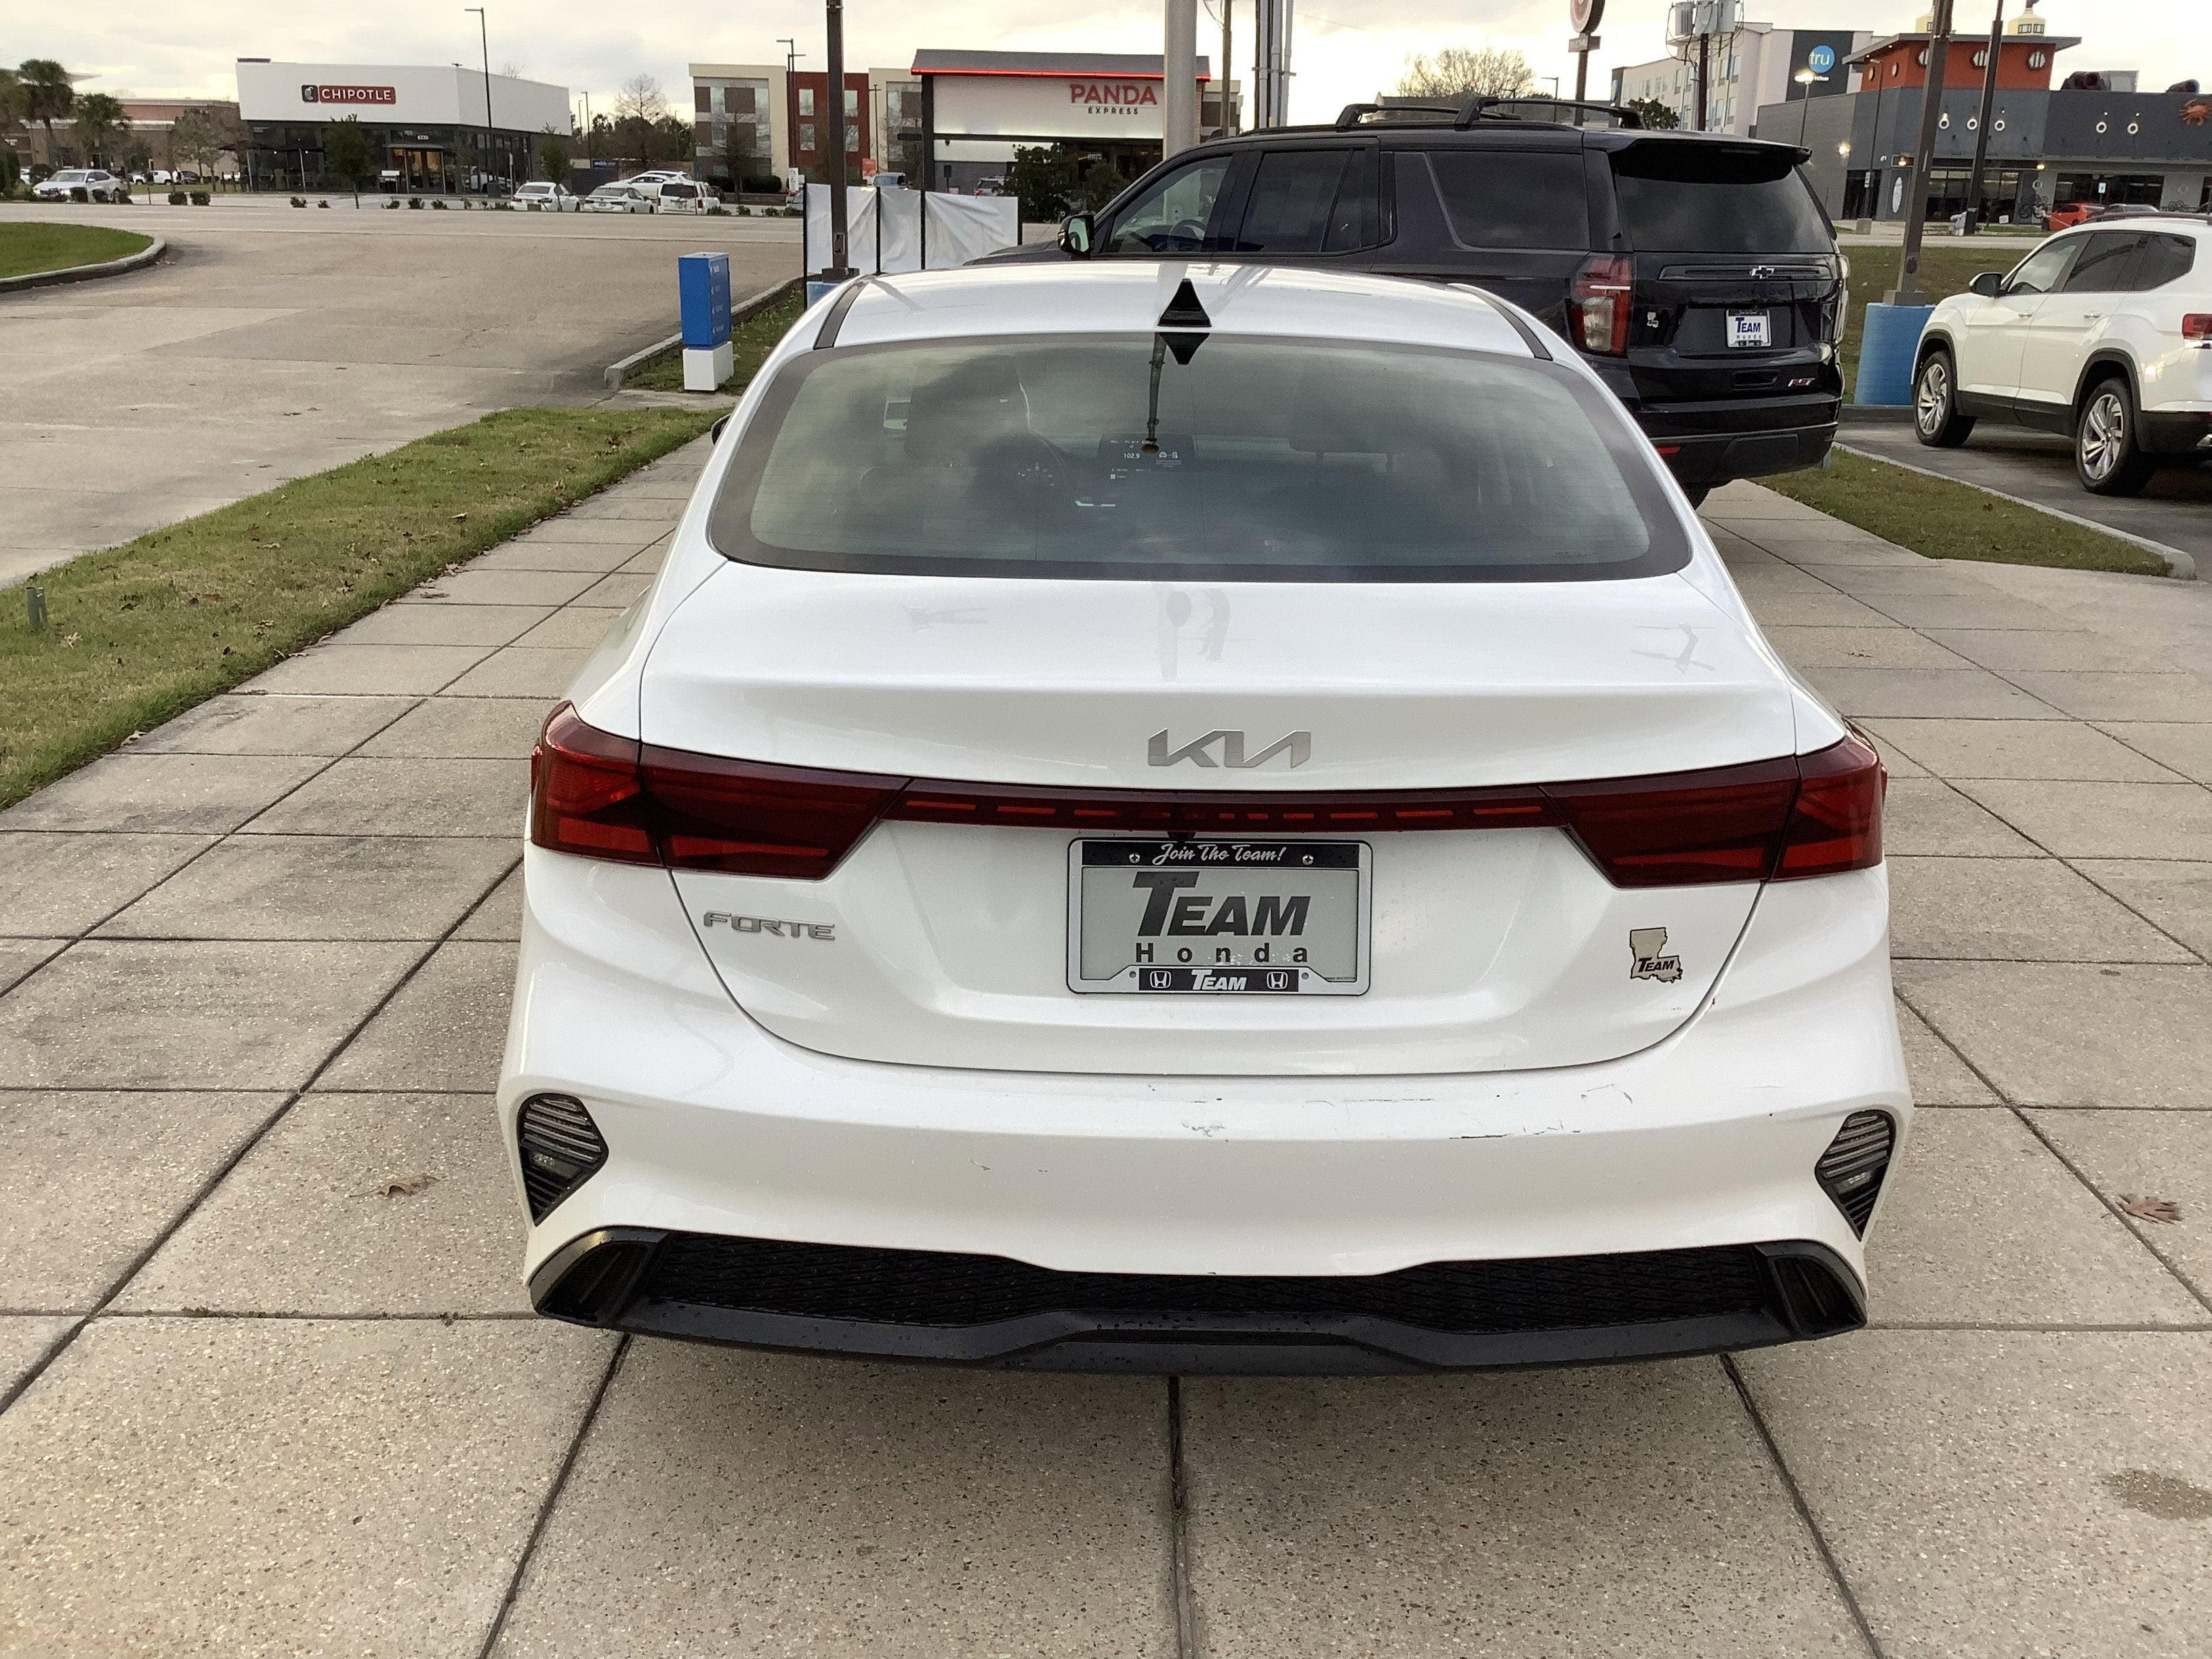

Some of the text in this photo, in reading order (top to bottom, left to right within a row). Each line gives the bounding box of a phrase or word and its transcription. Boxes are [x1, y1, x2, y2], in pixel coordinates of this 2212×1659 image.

[1809, 52, 1830, 66] tru
[321, 88, 392, 100] CHIPOTLE
[1070, 84, 1158, 105] PANDA
[1735, 316, 1761, 333] TEAM
[1152, 843, 1287, 865] Join The Team!
[1132, 871, 1311, 937] TEAM
[703, 910, 835, 940] FORTE
[1135, 942, 1308, 963] Honda
[1638, 956, 1675, 973] TEAM
[1191, 969, 1247, 991] TEAM
